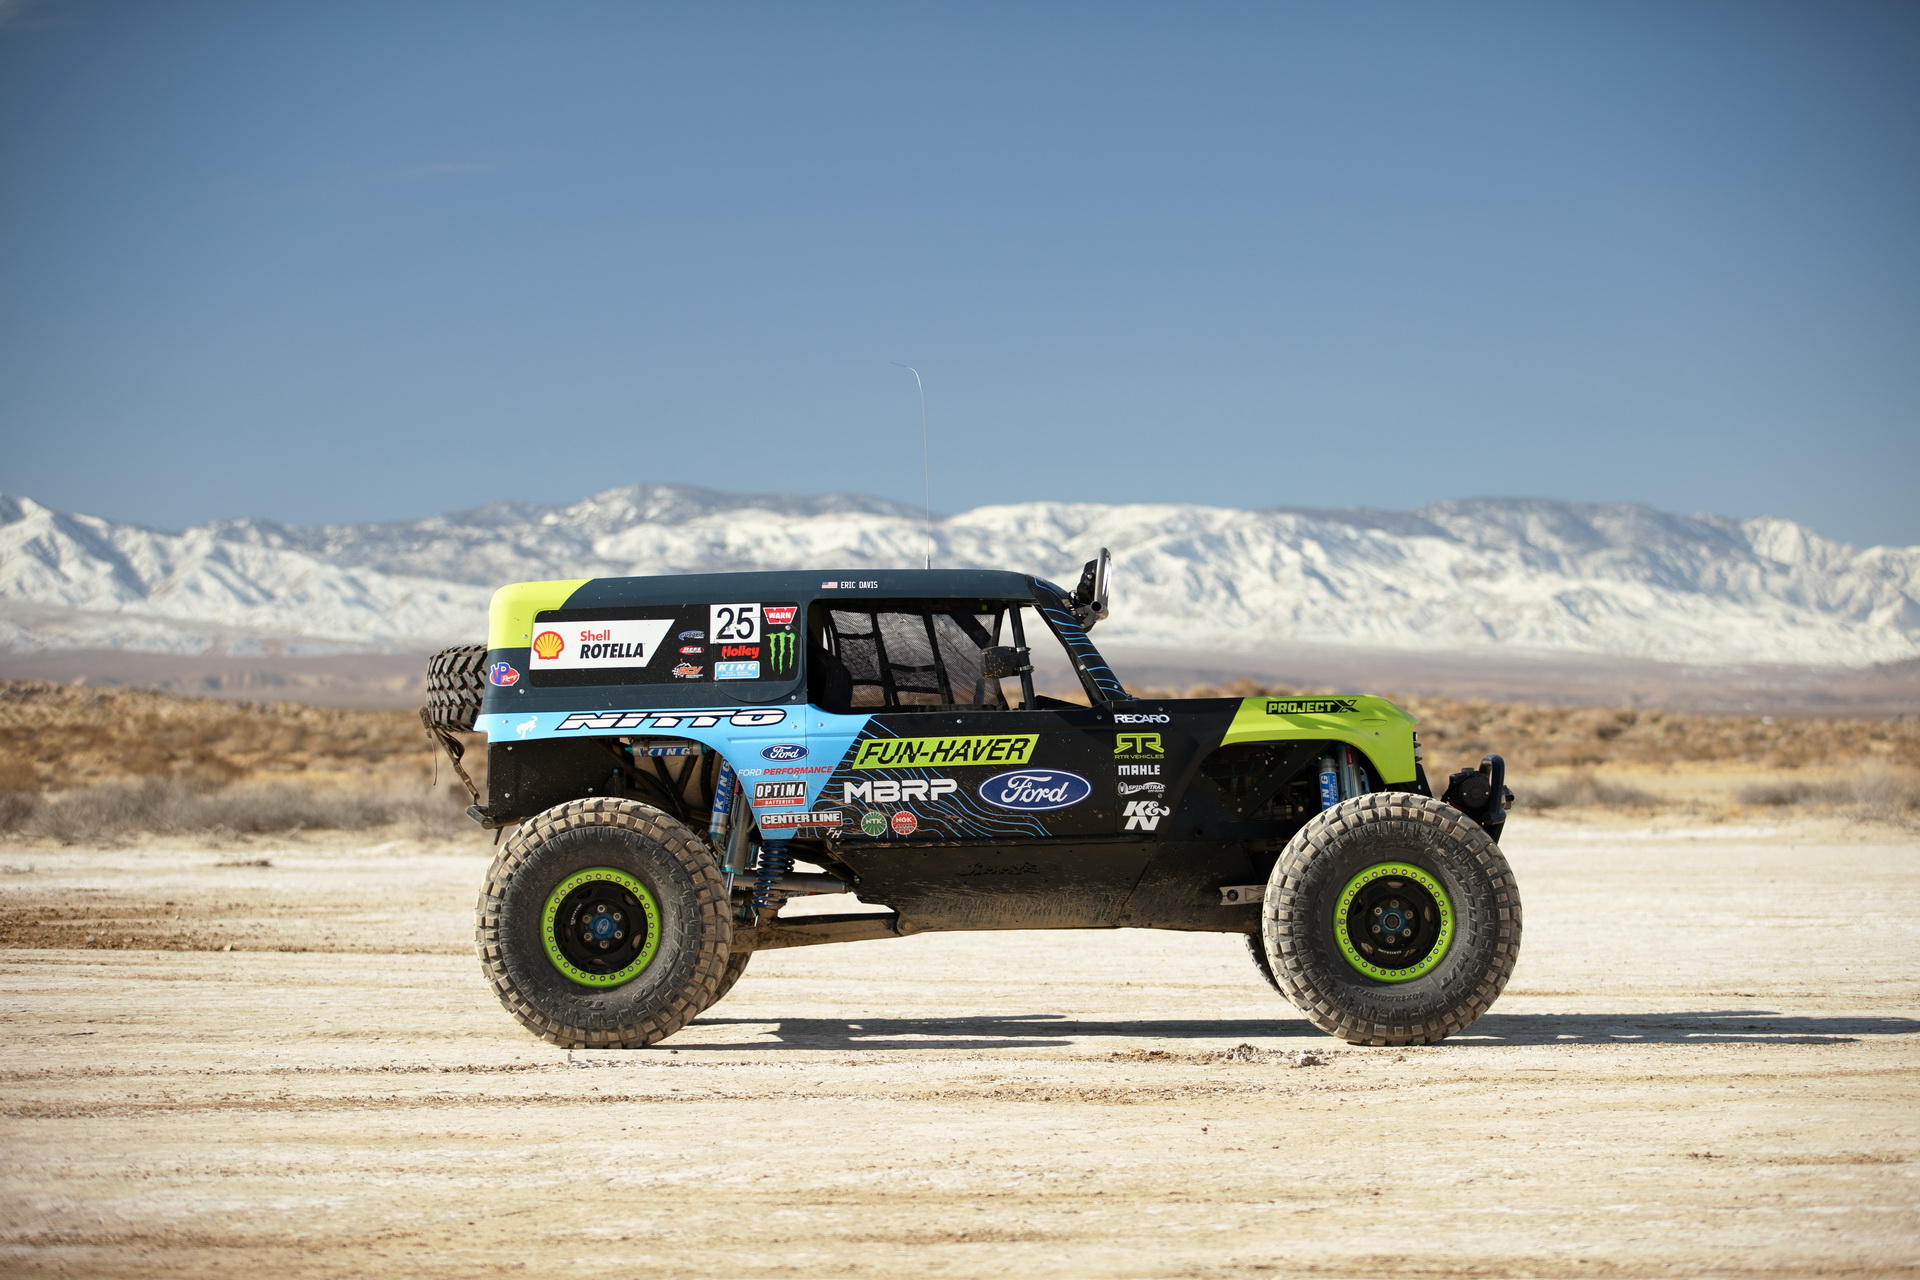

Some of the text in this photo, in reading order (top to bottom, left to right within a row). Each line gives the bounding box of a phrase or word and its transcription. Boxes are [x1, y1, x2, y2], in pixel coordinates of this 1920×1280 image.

[840, 581, 878, 589] ERIC DAVIS
[716, 607, 754, 640] 25
[580, 629, 610, 641] Shell
[579, 643, 644, 659] ROTELLA
[721, 645, 760, 659] Holley
[490, 661, 509, 684] VP
[717, 663, 757, 671] KING
[1268, 700, 1361, 713] PROJECT X
[555, 708, 787, 731] NITTO
[1114, 714, 1170, 723] RECARO
[770, 746, 799, 759] Ford
[859, 738, 1031, 765] FUN-HAVER
[737, 766, 834, 777] FORD PERFORMANCE
[1118, 765, 1161, 776] MAHLE
[715, 760, 731, 811] KING
[756, 783, 805, 798] OPTIMA
[843, 778, 958, 804] MBRP
[1001, 775, 1070, 803] Ford
[761, 813, 841, 824] CENTER LINE
